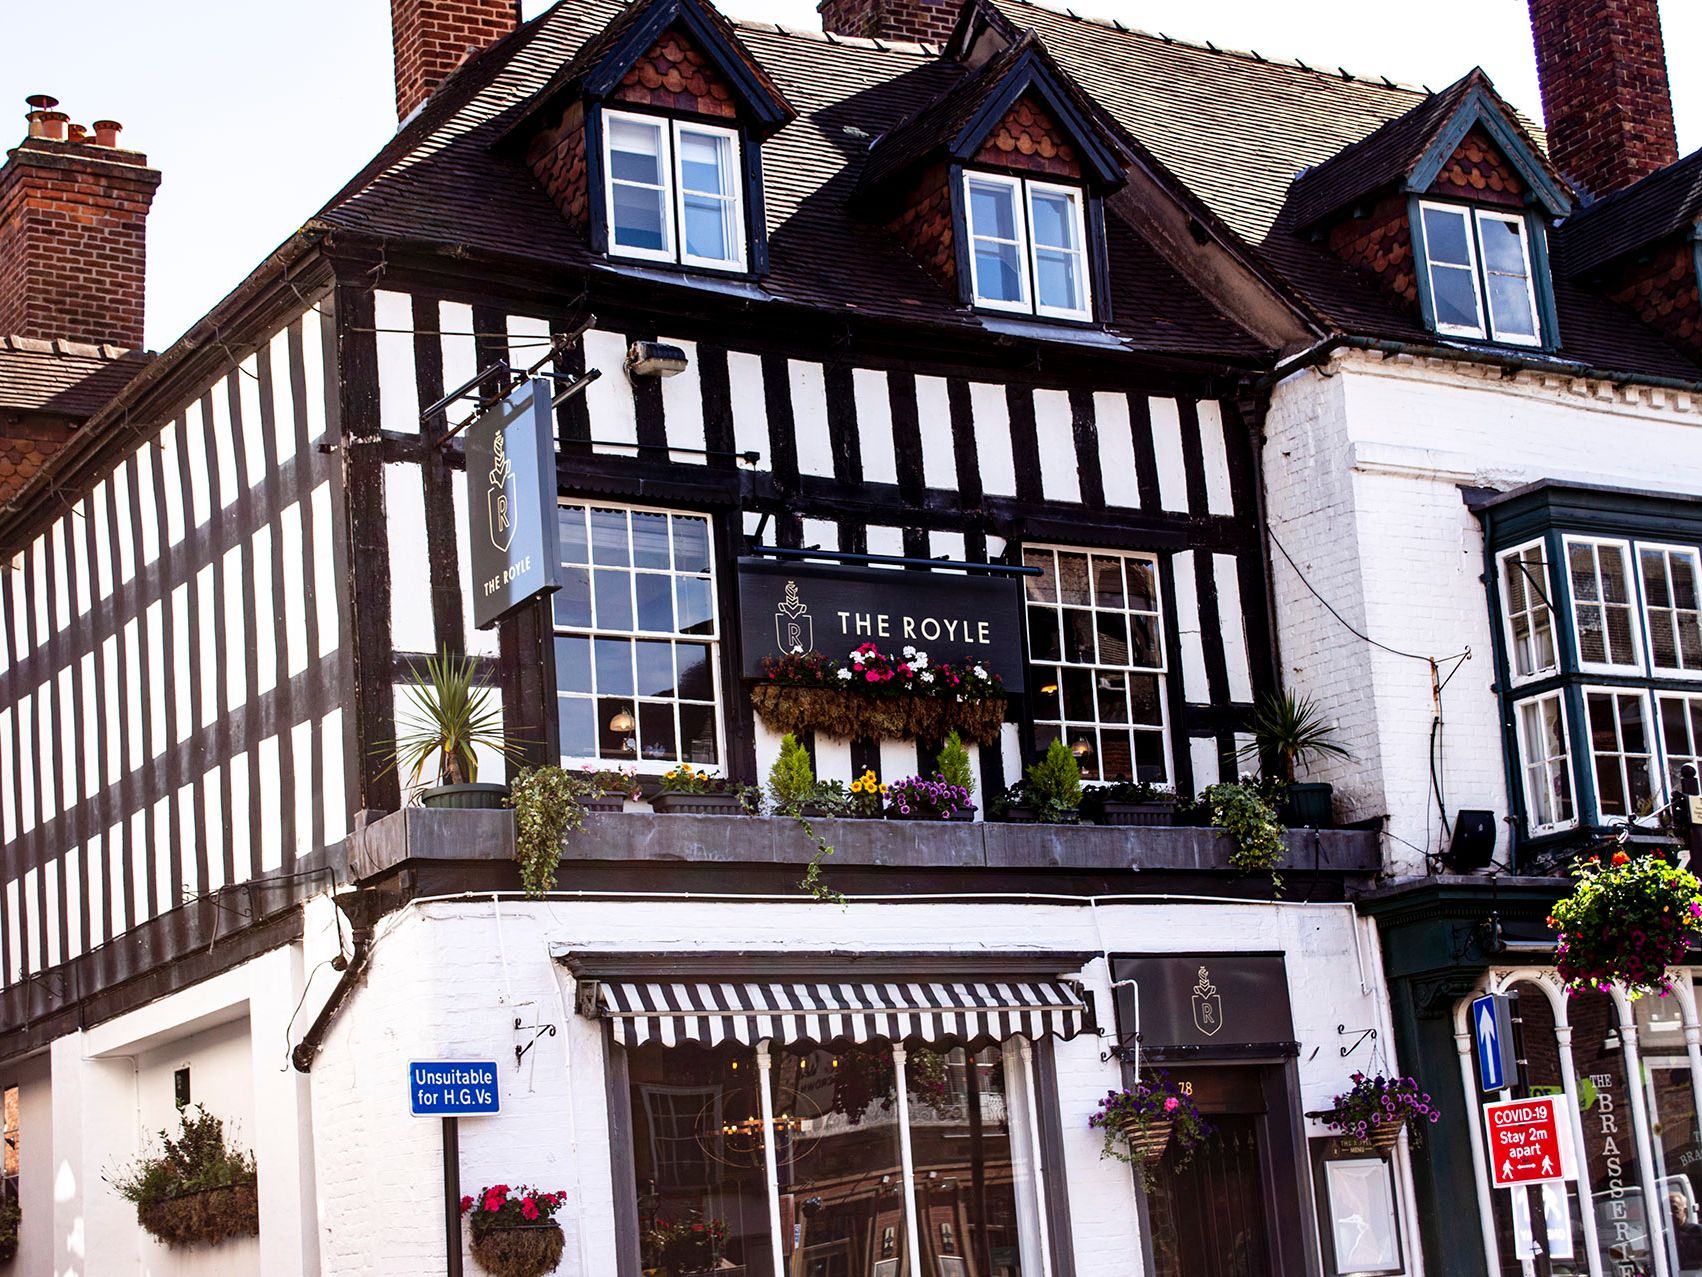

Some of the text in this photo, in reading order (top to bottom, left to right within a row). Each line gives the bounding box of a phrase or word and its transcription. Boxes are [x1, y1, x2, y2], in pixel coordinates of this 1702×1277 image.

[497, 494, 511, 532] R
[483, 556, 532, 597] THE ROYLE
[787, 623, 802, 648] R
[837, 611, 990, 644] THE ROYLE
[1202, 1002, 1215, 1024] R
[415, 1069, 492, 1085] Unsuitable
[1589, 1073, 1612, 1088] THE
[418, 1089, 492, 1105] for H.G.Vs
[1178, 1081, 1193, 1096] 78
[1494, 1105, 1548, 1124] COVID-19
[1500, 1127, 1548, 1145] Stay 2m
[1509, 1143, 1541, 1159] apart
